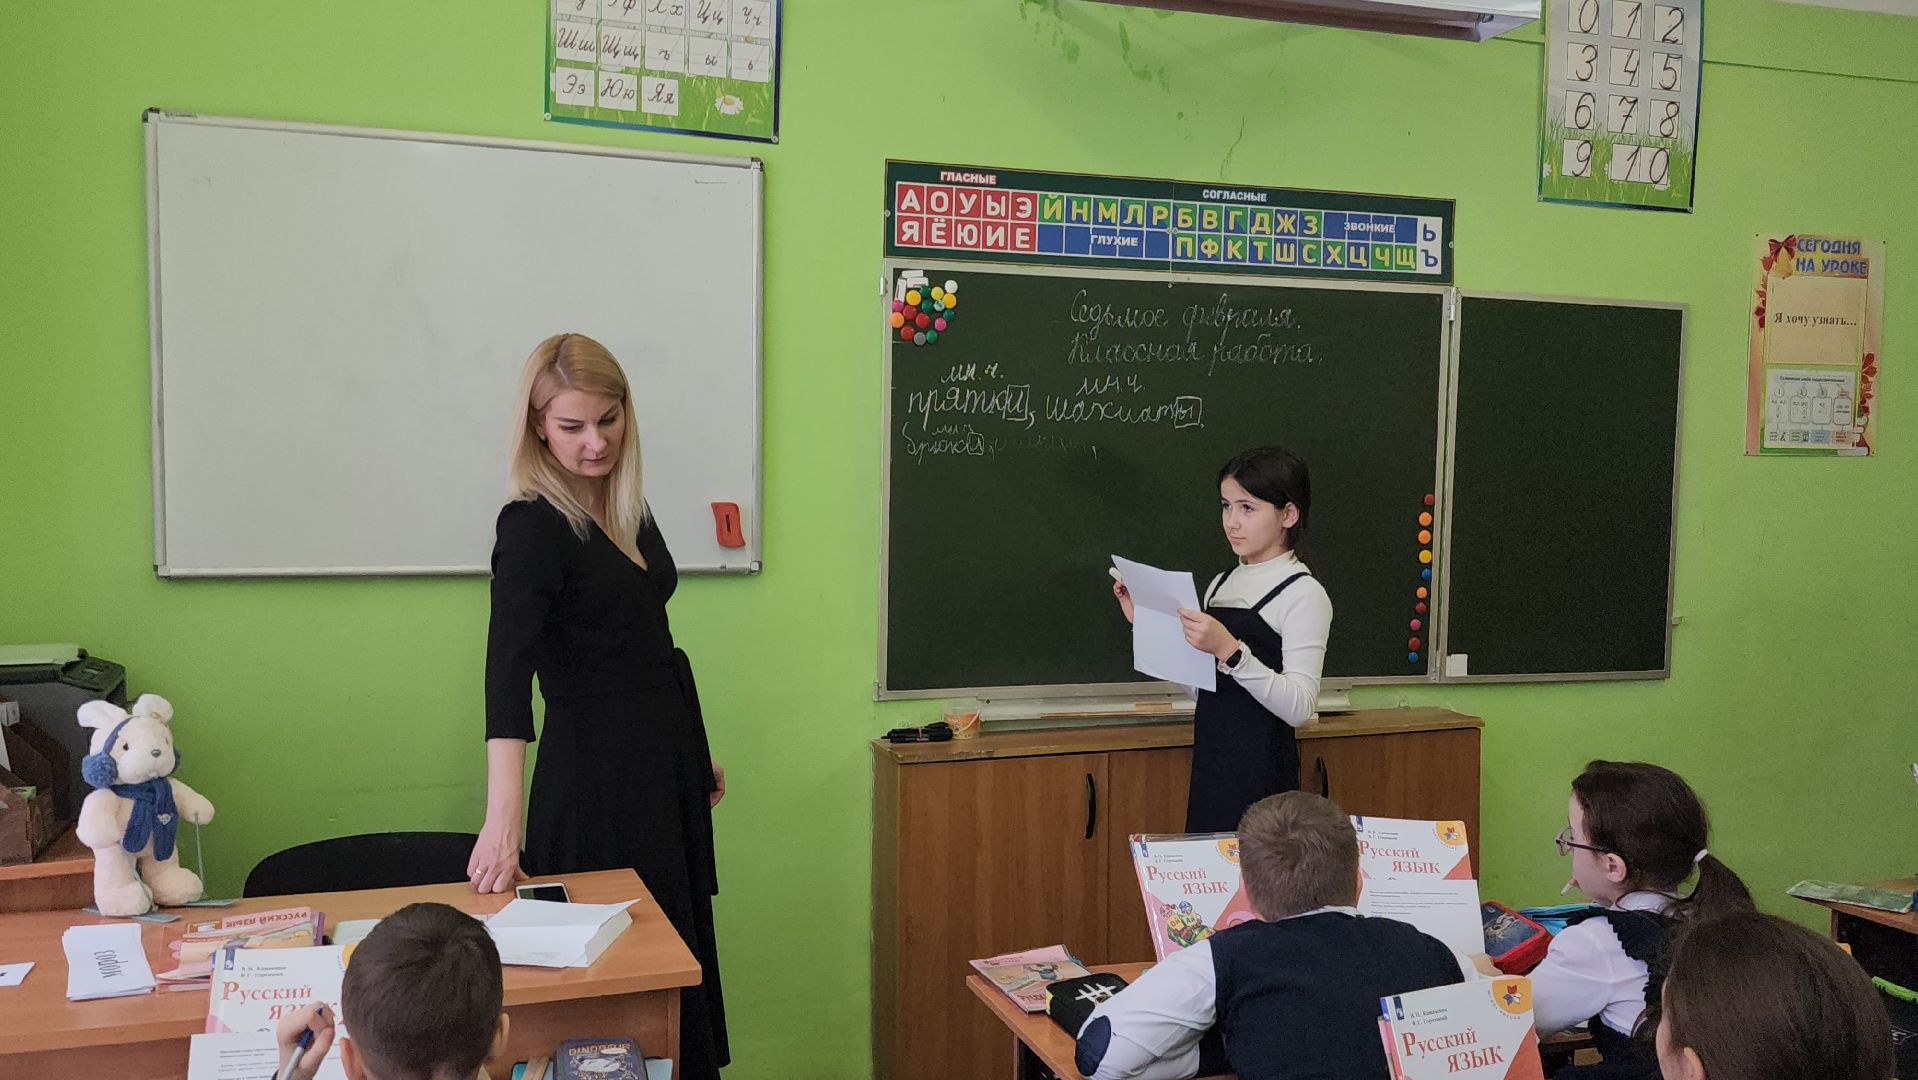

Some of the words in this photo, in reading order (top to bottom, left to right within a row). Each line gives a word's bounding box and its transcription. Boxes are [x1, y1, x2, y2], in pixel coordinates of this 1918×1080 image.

[1627, 2, 1643, 37] 1
[1661, 7, 1684, 43] 2
[557, 27, 597, 52] Шш
[600, 34, 639, 60] Щщ
[704, 54, 719, 66] ы
[1575, 45, 1598, 81] 3
[1623, 49, 1640, 86] 4
[1658, 53, 1683, 90] 5
[562, 74, 586, 95] Ээ
[600, 78, 635, 100] Юю
[647, 83, 675, 104] Яя
[1574, 92, 1596, 129] 6
[1618, 95, 1638, 133] 7
[1659, 101, 1680, 138] 8
[1571, 140, 1593, 177] 9
[1624, 146, 1670, 184] 10
[940, 171, 997, 185] ГЛАСНЫЕ
[1202, 188, 1267, 202] СОГЛАСНЫЕ
[1343, 221, 1396, 234] ЗВОНКИЕ
[1091, 234, 1139, 247] ГЛУХИЕ
[1796, 238, 1861, 255] СЕГОДНЯ
[1795, 258, 1815, 272] НА
[1821, 258, 1867, 275] УРОКЕ
[1070, 289, 1168, 342] Седьмое
[1774, 312, 1782, 324] Я
[1786, 314, 1811, 327] хочу
[1359, 840, 1420, 858] Русский
[1145, 865, 1207, 883] Русский
[222, 980, 312, 1004] Русский
[1402, 1026, 1477, 1059] Русский
